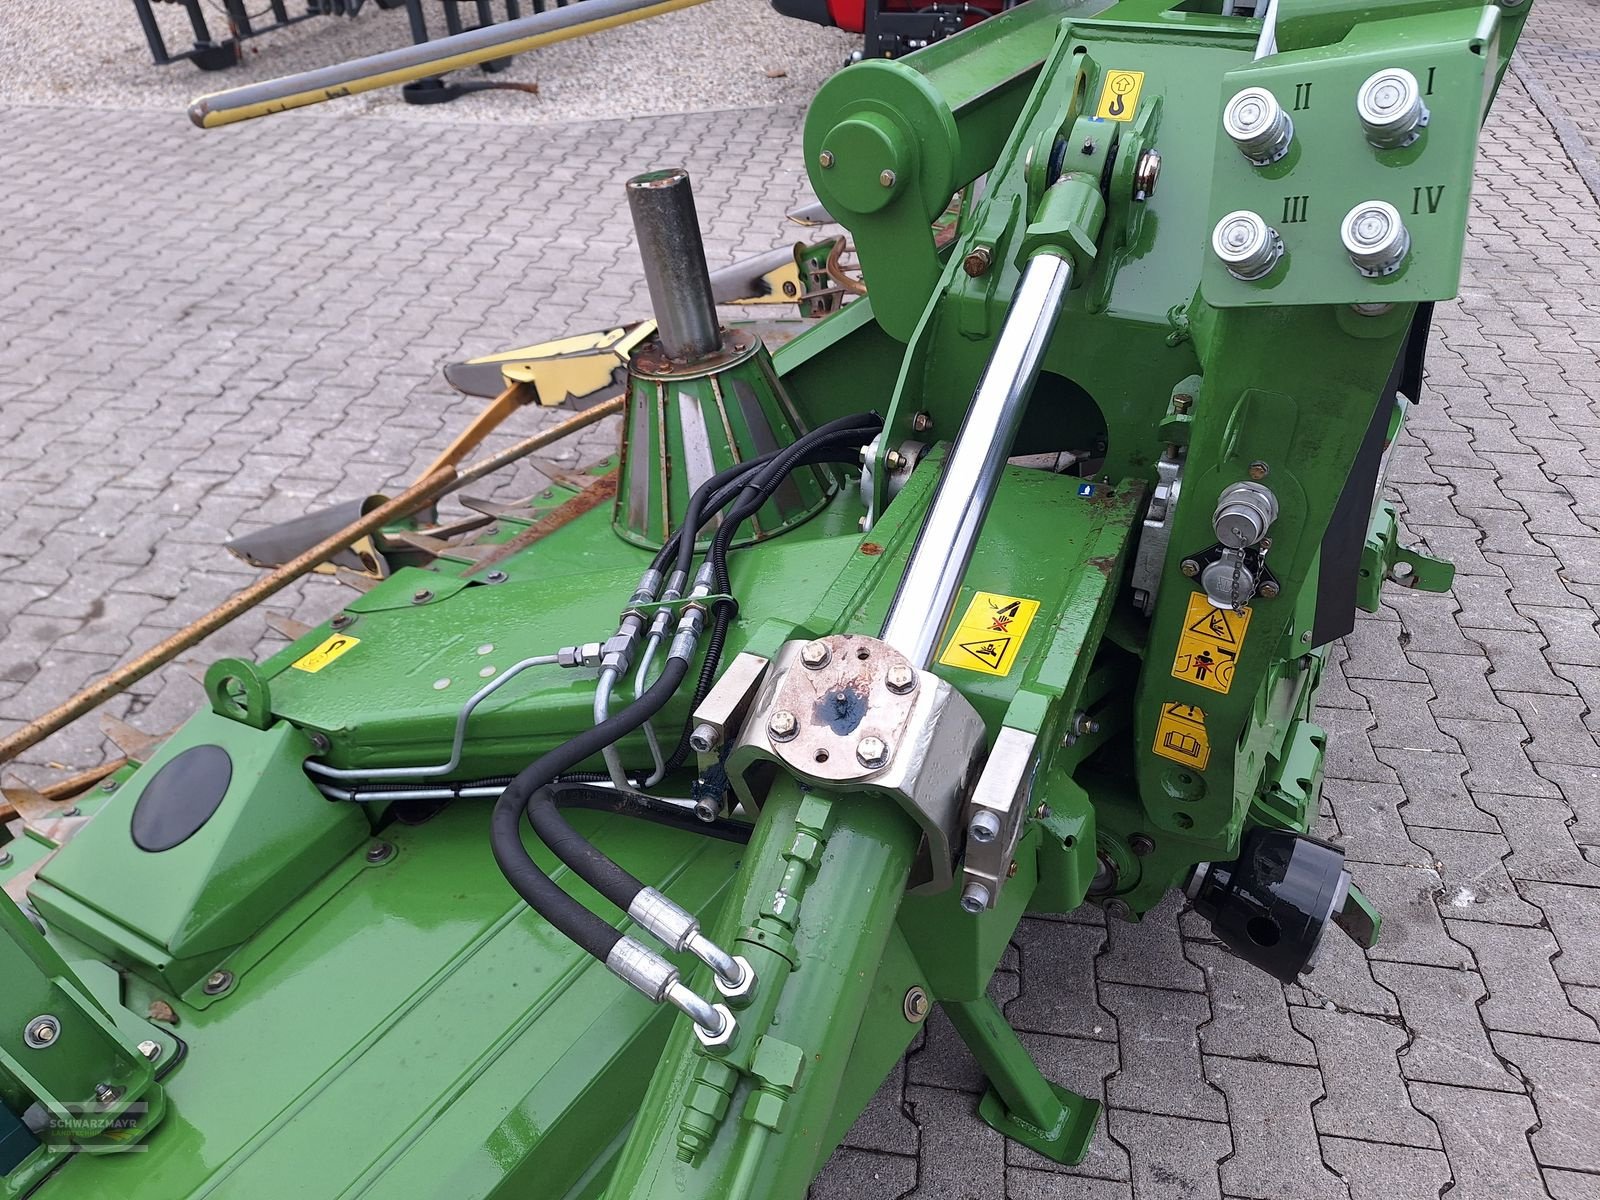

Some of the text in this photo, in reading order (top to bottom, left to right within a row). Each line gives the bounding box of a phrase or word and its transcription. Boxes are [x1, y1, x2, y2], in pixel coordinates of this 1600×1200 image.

[1425, 67, 1436, 96] I
[1293, 82, 1312, 111] II
[1281, 195, 1309, 223] III
[1410, 185, 1445, 215] IV
